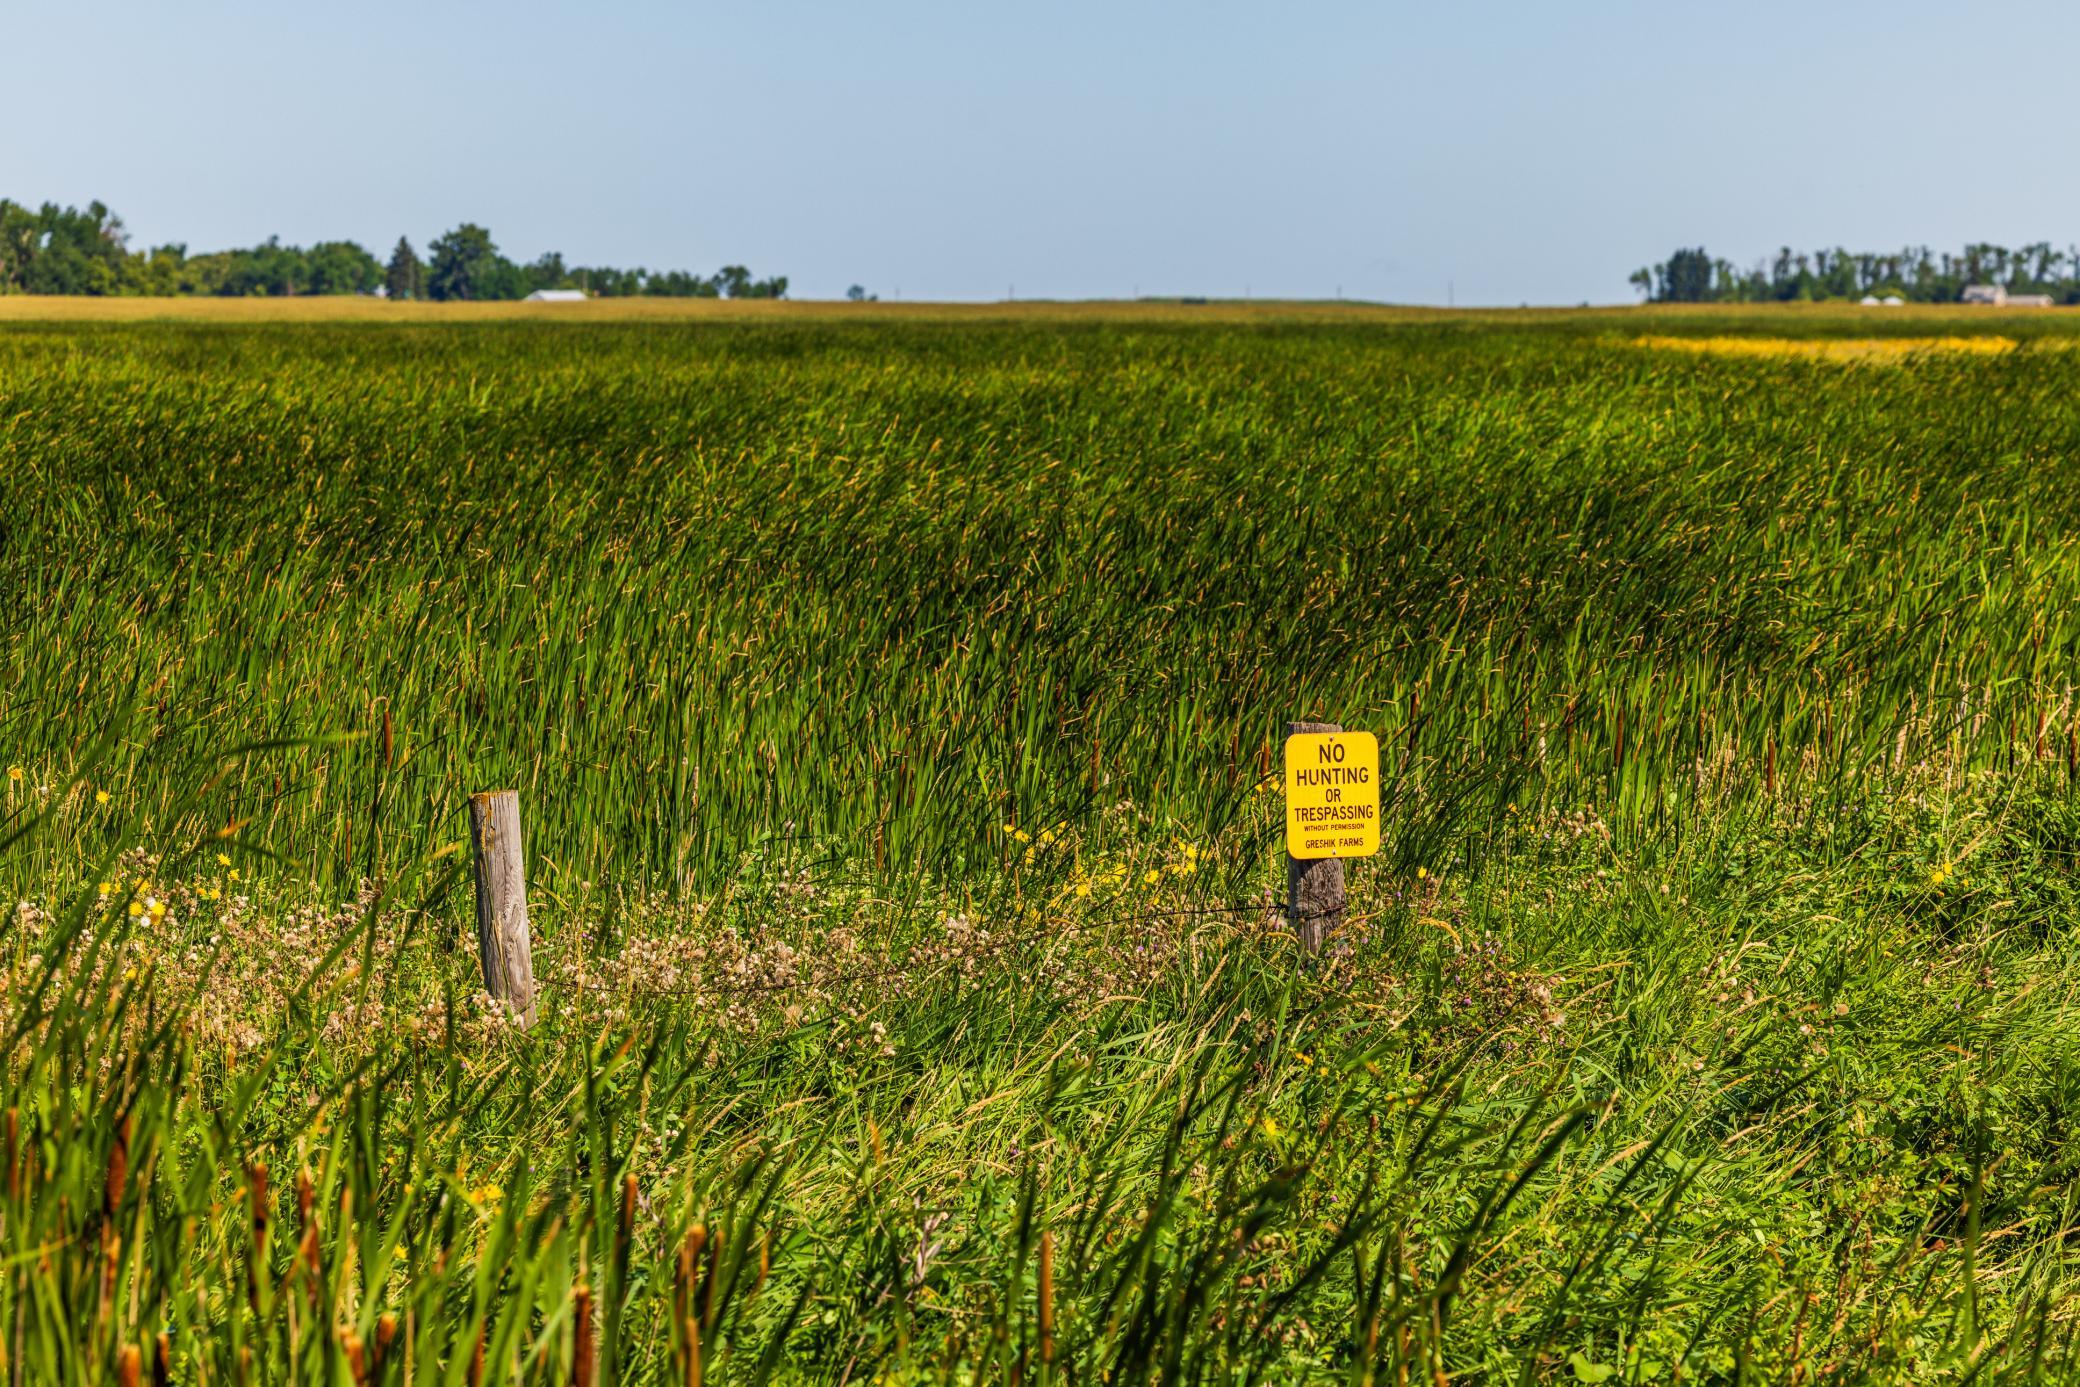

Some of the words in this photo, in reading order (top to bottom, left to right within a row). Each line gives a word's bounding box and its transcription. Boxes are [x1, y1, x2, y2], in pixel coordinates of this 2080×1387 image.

[1319, 744, 1345, 763] NO
[1296, 767, 1369, 786] HUNTING
[1325, 788, 1341, 803] OR
[1294, 804, 1373, 822] TRESPASSING
[1304, 824, 1329, 832] WITHOUT
[1331, 823, 1365, 831] PERMISSION
[1305, 839, 1336, 849] GRESHIK
[1339, 837, 1364, 847] FARMS
